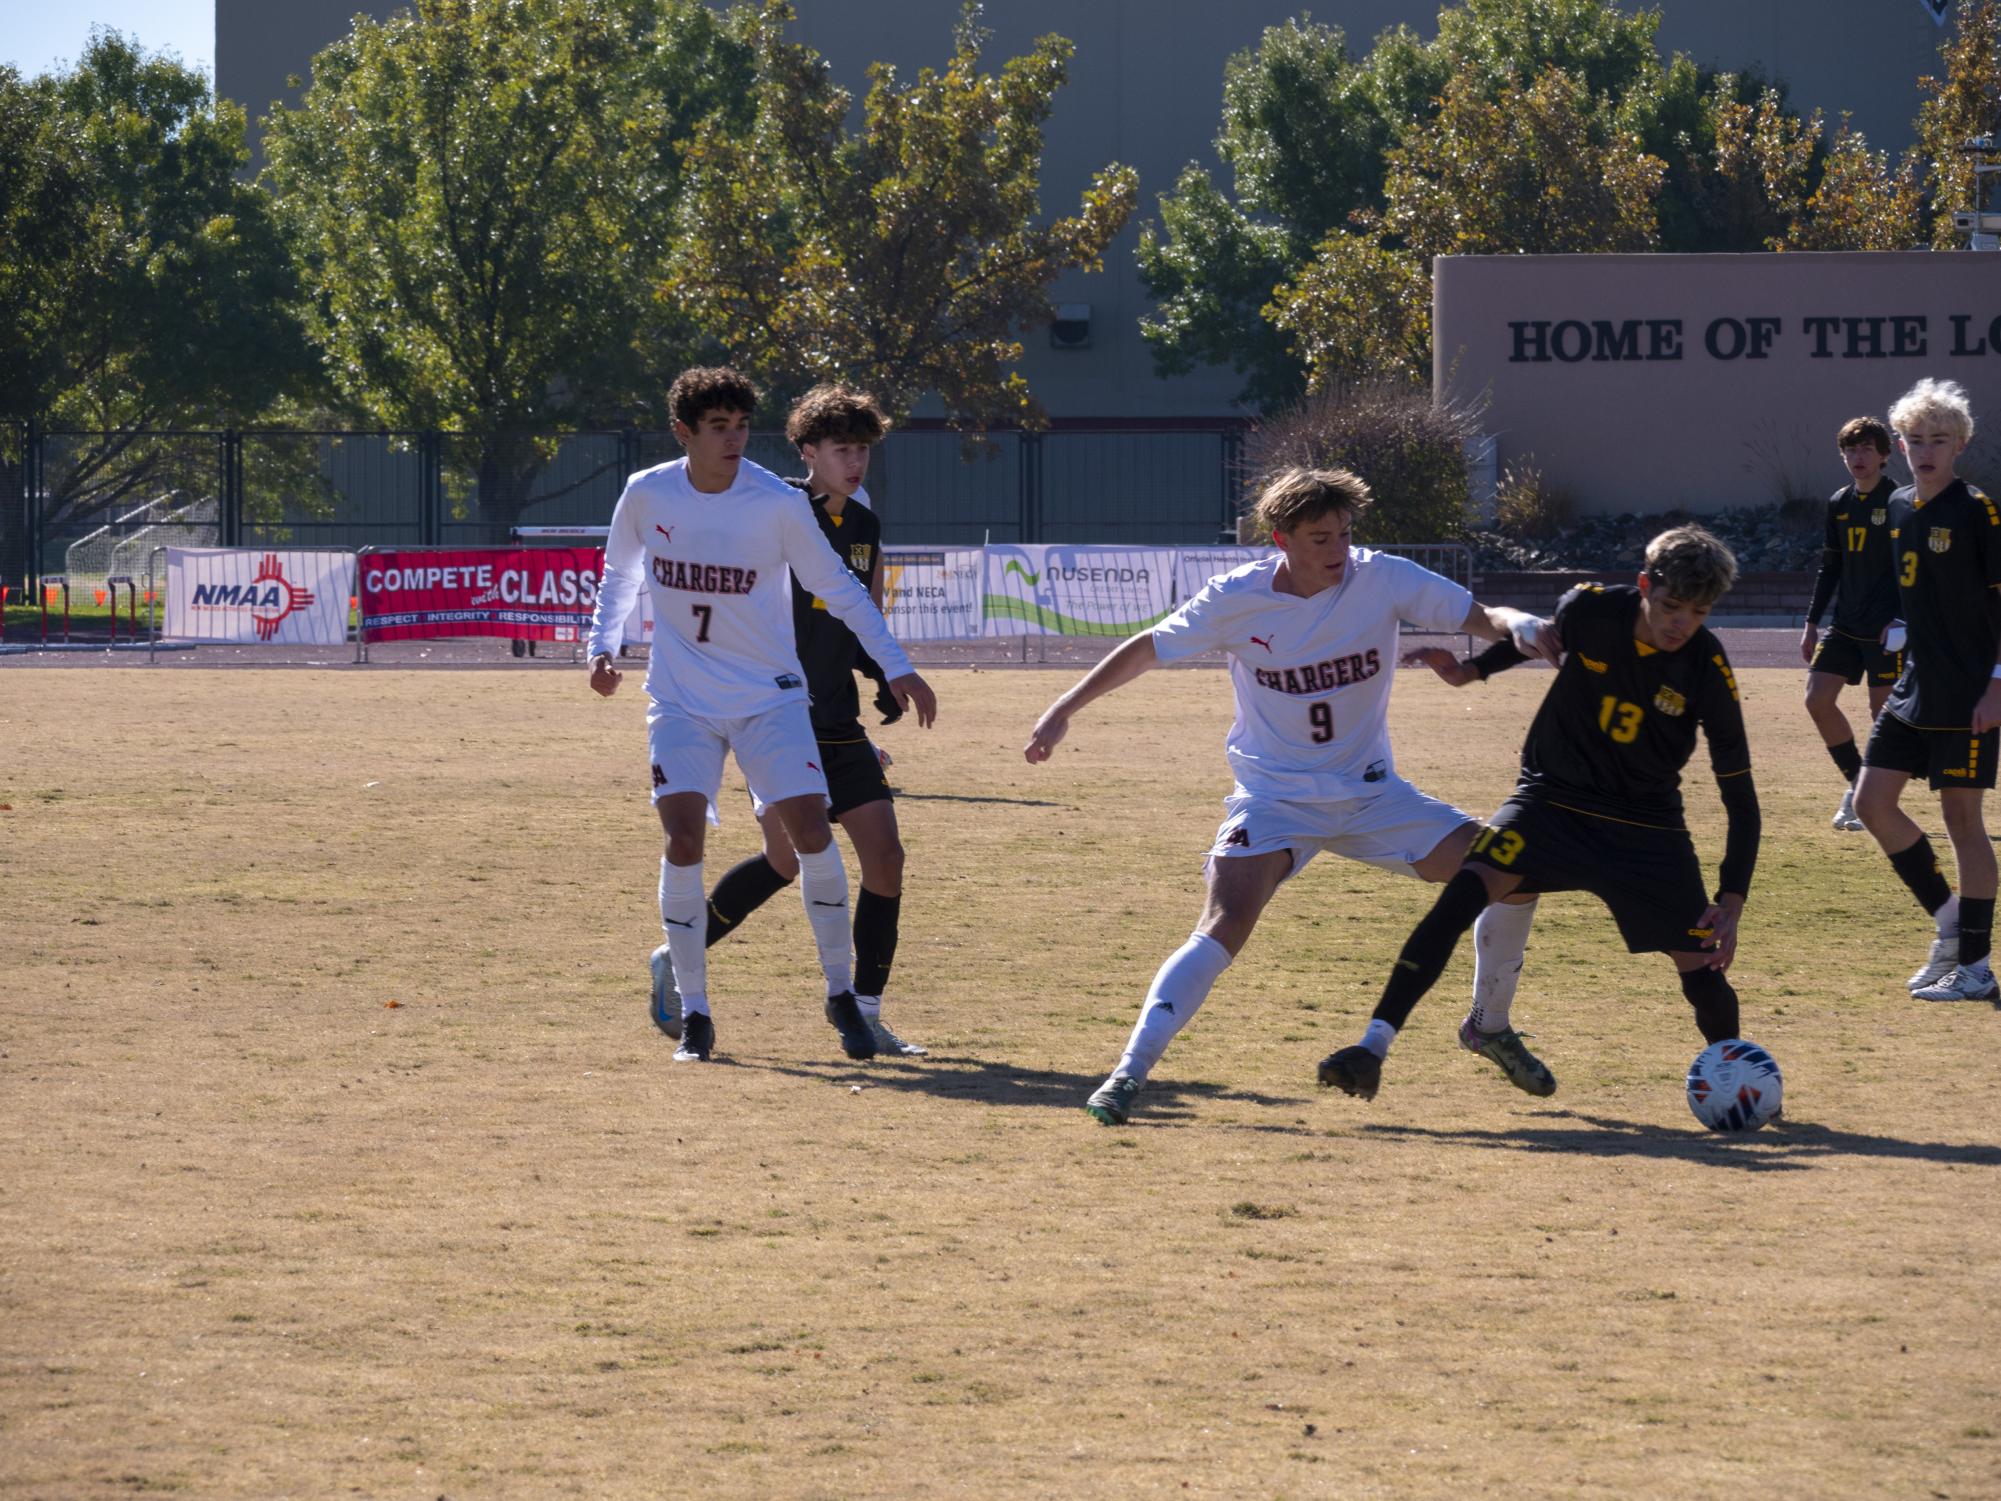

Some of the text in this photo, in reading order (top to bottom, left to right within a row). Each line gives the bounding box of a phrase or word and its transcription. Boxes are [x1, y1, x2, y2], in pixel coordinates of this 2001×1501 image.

[1507, 319, 1684, 363] HOME
[1704, 316, 1782, 361] OF
[1803, 315, 1928, 359] THE
[1847, 526, 1867, 552] 17
[366, 565, 597, 606] COMPETE with CLASS
[652, 556, 758, 595] CHARGERS
[1899, 550, 1918, 588] 3
[191, 583, 280, 607] NMAA
[892, 586, 913, 598] and
[916, 586, 945, 598] NECA
[919, 602, 938, 614] this
[364, 610, 595, 627] RESPECT INTEGRITY RESPONSIBILITY
[691, 603, 712, 643] 7
[1255, 647, 1380, 696] CHARGERS
[1308, 701, 1334, 745] 9
[1599, 694, 1645, 744] 13
[1474, 826, 1526, 866] 13
